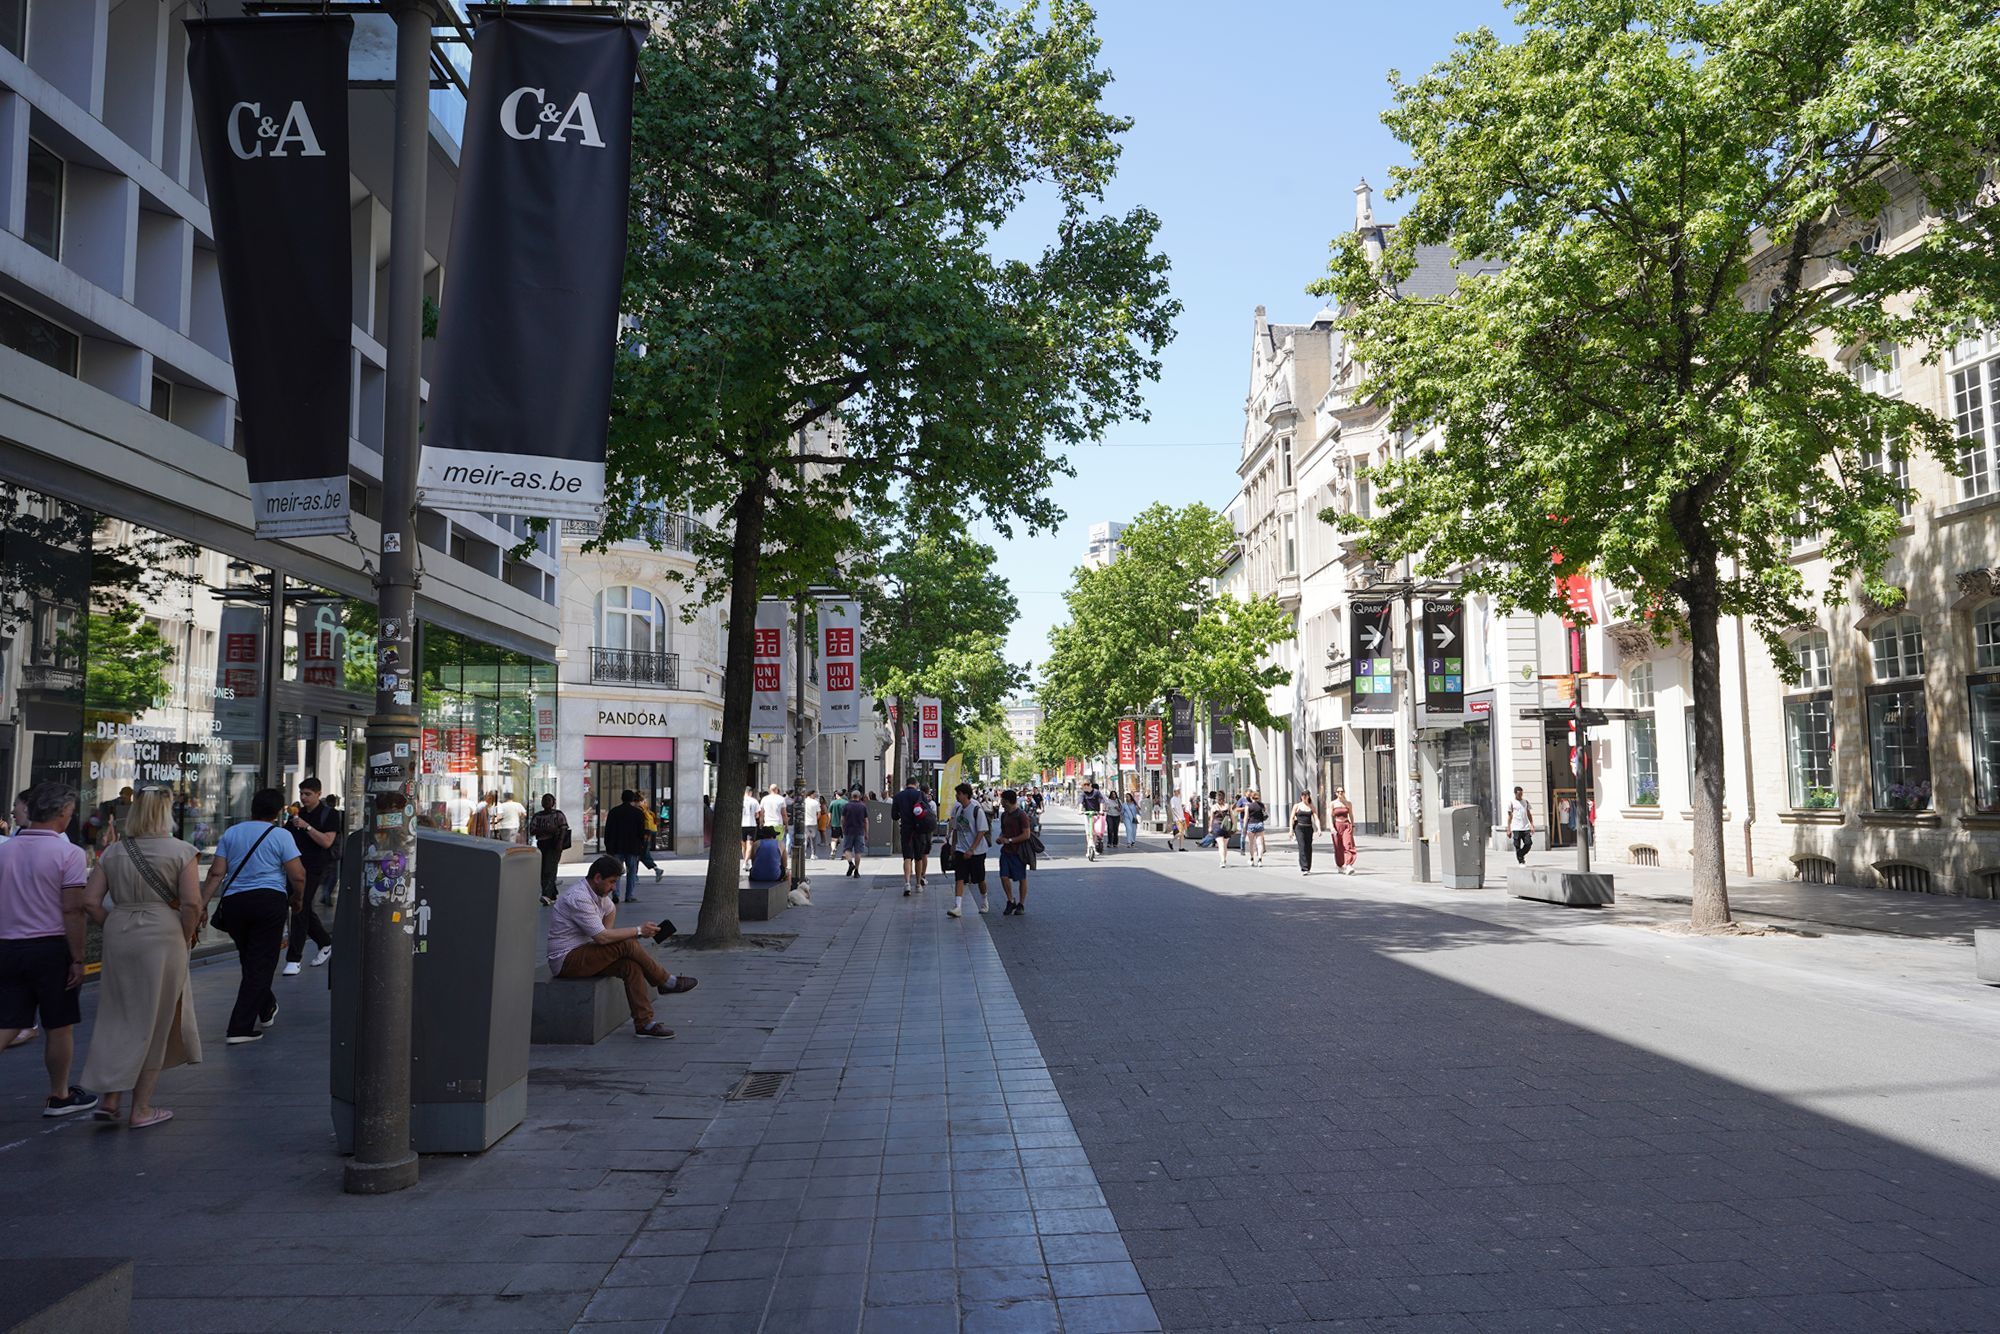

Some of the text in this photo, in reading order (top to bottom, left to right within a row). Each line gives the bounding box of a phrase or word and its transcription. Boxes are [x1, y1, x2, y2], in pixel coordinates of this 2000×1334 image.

[500, 86, 606, 148] C&A
[227, 101, 326, 160] C&A
[443, 464, 582, 493] meir-as.be
[266, 489, 341, 513] meir-as.be
[829, 666, 849, 676] UNI
[829, 677, 851, 689] QLO
[97, 721, 115, 739] DE
[598, 710, 668, 726] PANDORA
[1122, 724, 1132, 761] HEMA
[1148, 723, 1159, 760] HEMA
